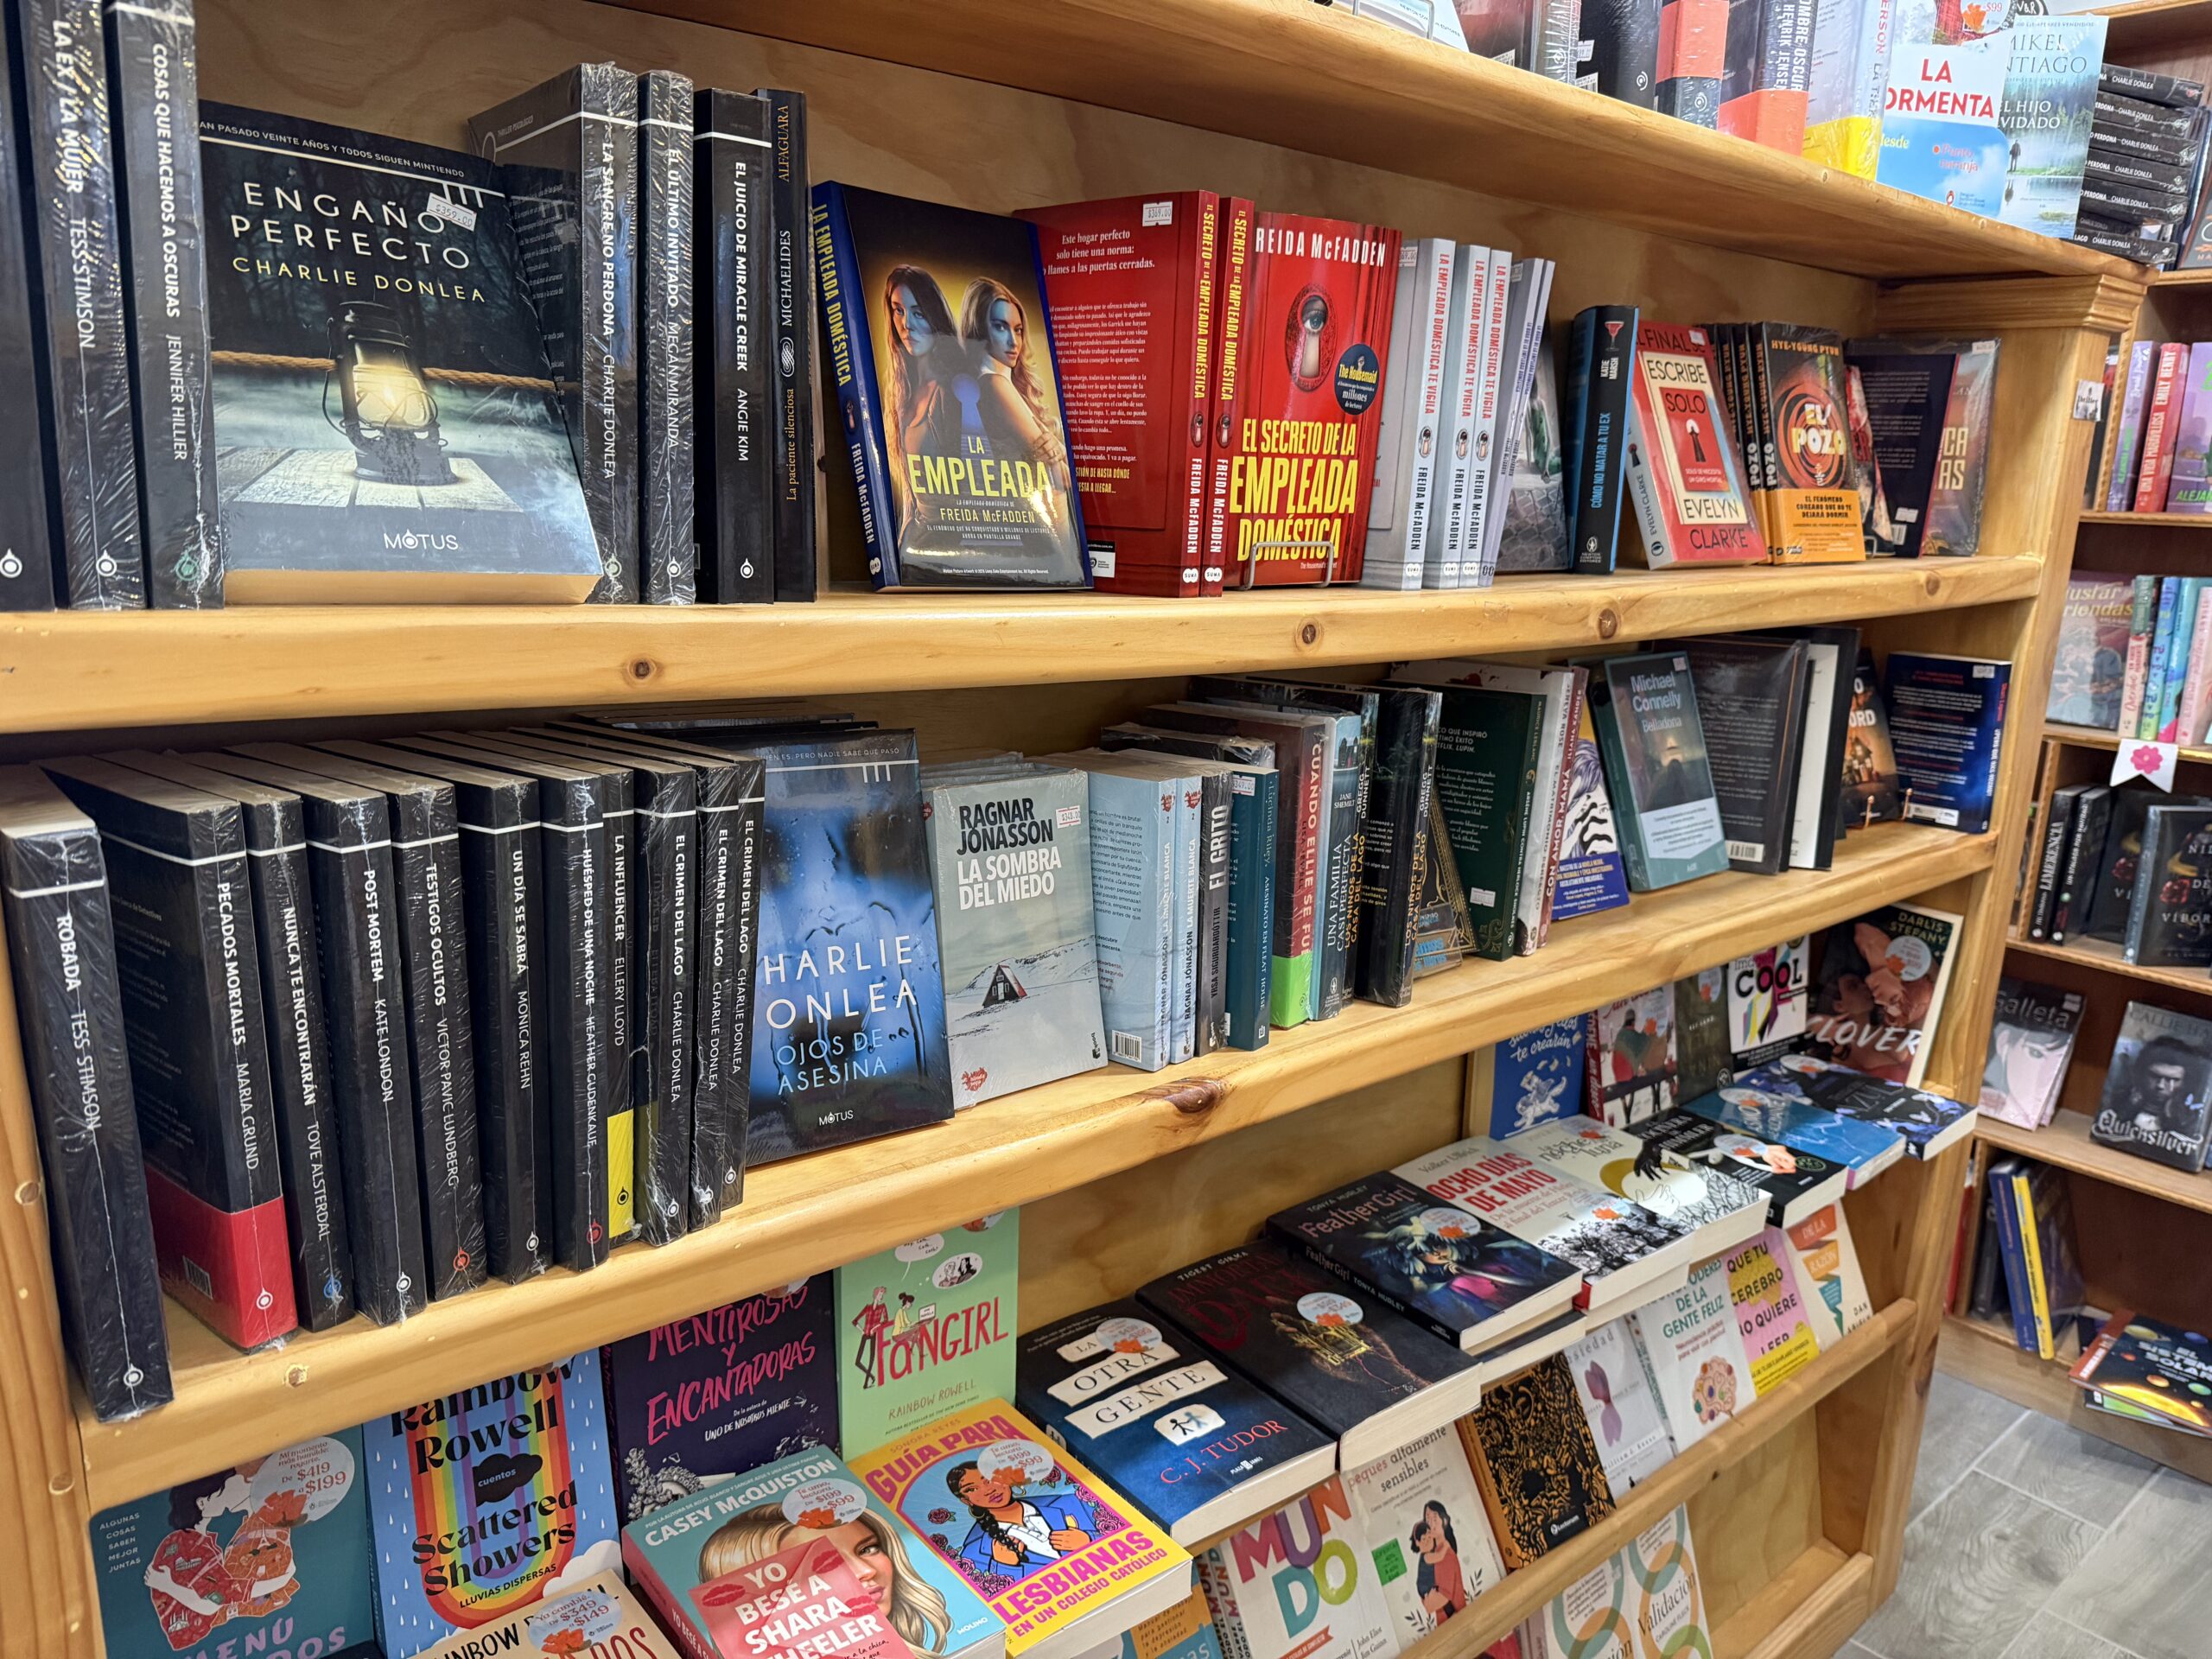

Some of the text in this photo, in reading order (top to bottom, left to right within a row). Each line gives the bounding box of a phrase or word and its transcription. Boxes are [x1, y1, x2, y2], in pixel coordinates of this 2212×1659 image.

[1921, 59, 1953, 84] LA
[1885, 88, 1994, 119] ORMENTA
[2016, 100, 2051, 114] HIJO
[218, 124, 260, 138] PASADO
[262, 132, 300, 145] VEINTE
[302, 138, 329, 151] AÑOS
[340, 146, 373, 159] TODOS
[375, 153, 410, 167] SIGUEN
[413, 160, 465, 177] MINTIENDO
[778, 105, 790, 183] ALFAGUARA
[152, 43, 180, 318] COSAS QUE HACEMOS A OSCURAS
[244, 181, 445, 234] ENGAÑO
[231, 214, 470, 270] PERFECTO
[1056, 245, 1135, 260] solo tiene una norma:
[1062, 229, 1130, 245] Este hogar perfecto
[2093, 237, 2112, 247] CHARLIE
[2112, 239, 2131, 250] DONLEA
[232, 257, 485, 303] CHARLIE DONLEA
[734, 162, 748, 372] EL JUICIO DE MIRACLE CREEK
[780, 230, 792, 327] MICHAELIDES
[1048, 264, 1070, 275] llames
[1077, 263, 1088, 273] las
[1089, 261, 1117, 274] puertas
[1119, 257, 1154, 270] cerradas.
[1600, 359, 1610, 378] KATIE
[1609, 357, 1619, 380] MARSH
[1647, 359, 1707, 384] ESCRIBE
[166, 334, 188, 461] JENNIFER HILLIER
[1343, 389, 1367, 402] millones
[1665, 392, 1706, 414] SOLO
[737, 388, 749, 461] ANGIE KIM
[1242, 419, 1357, 456] EL SECRETO DE LA
[1599, 413, 1611, 424] EX
[1599, 425, 1609, 435] TU
[785, 388, 799, 502] La paciente silenciosa
[968, 436, 985, 454] LA
[1595, 446, 1607, 472] MATAR
[1791, 427, 1846, 455] POZO
[907, 454, 1052, 499] EMPLEADA
[1229, 456, 1358, 514] EMPLEADA
[1593, 473, 1604, 484] NO
[940, 508, 1035, 524] FREIDA McFADDEN
[1590, 486, 1603, 508] CÓMO
[1683, 499, 1738, 519] EVELYN
[383, 528, 459, 551] MOTUS
[1237, 509, 1341, 562] DOMÉSTICA
[1690, 529, 1749, 550] CLARKE
[1630, 673, 1676, 693] Michael
[1632, 690, 1681, 713] Connelly
[1641, 716, 1682, 734] Belladona
[959, 798, 1035, 830] RAGNAR
[957, 818, 1054, 856] JÓNASSON
[2042, 820, 2065, 892] LIMERENCIA
[957, 846, 1062, 887] LA SOMBRA
[958, 871, 1055, 911] DEL MIEDO
[1327, 843, 1342, 947] UNA FAMILIA
[1337, 835, 1351, 951] CASI PERFECTA
[613, 835, 625, 1046] LA INFLUENCER ELLERY LLOYD
[1735, 957, 1803, 998] COOL
[56, 915, 102, 1130] ROBADA TESS STIMSON
[217, 882, 259, 1171] PECADOS MORTALES MARIA GRUND
[777, 1027, 885, 1067] OJOS DE
[778, 1057, 888, 1096] ASESINA
[818, 1109, 854, 1127] MOTUS
[2092, 1109, 2202, 1158] Quicksilver
[1426, 1153, 1534, 1202] OCHO DÍAS
[1464, 1167, 1558, 1213] DE MAYO
[721, 1344, 736, 1367] Y
[1073, 1349, 1161, 1393] OTRA
[646, 1331, 816, 1446] ENCANTADORAS
[888, 1378, 977, 1421] RAINBOW ROWELL
[1095, 1369, 1208, 1425] GENTE
[413, 1395, 561, 1476] Rowell
[705, 1397, 791, 1441] UNO DE NOSOTROS MIENTE
[865, 1414, 1026, 1505] GUÍA PARA
[1200, 1419, 1289, 1463] TUDOR
[1389, 1425, 1447, 1466] altamente
[297, 1462, 330, 1481] $419
[305, 1471, 346, 1495] $199
[477, 1467, 517, 1488] cuentos
[1380, 1457, 1430, 1495] sensibles
[99, 1511, 141, 1531] ALGUNAS
[411, 1479, 579, 1567] Scattered
[644, 1458, 838, 1548] CASEY McQUISTON
[106, 1524, 137, 1540] COSAS
[108, 1535, 137, 1551] SABEN
[108, 1546, 139, 1562] MEJOR
[108, 1556, 142, 1573] JUNTAS
[423, 1519, 576, 1597] Showers
[459, 1563, 558, 1609] LLUVIAS DISPERSAS
[744, 1561, 787, 1591] YO
[992, 1529, 1155, 1625] LESBIANAS
[1012, 1548, 1168, 1638] EN UN COLEGIO CATÓLICO
[735, 1573, 830, 1626] BESÉ A
[1638, 1571, 1696, 1637] Validación
[743, 1597, 852, 1656] SHARA
[957, 1616, 988, 1636] MOLINO
